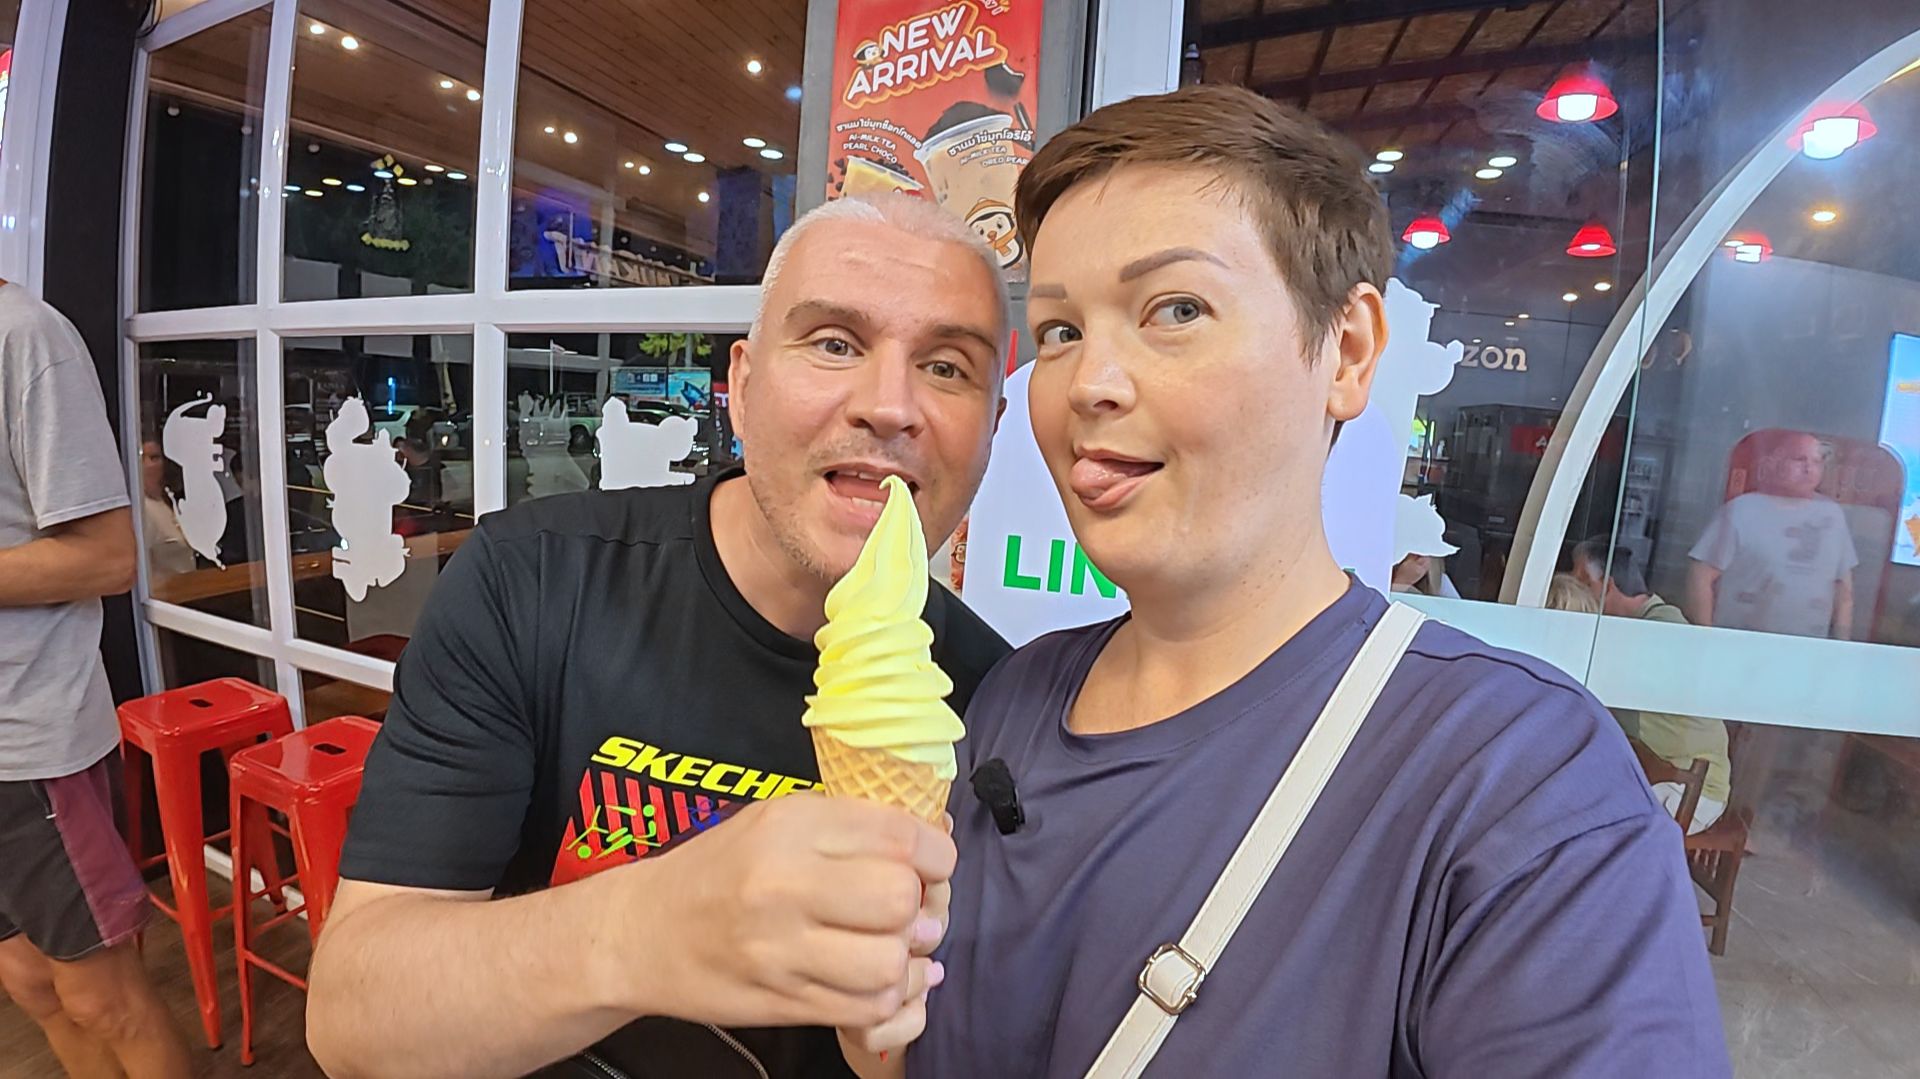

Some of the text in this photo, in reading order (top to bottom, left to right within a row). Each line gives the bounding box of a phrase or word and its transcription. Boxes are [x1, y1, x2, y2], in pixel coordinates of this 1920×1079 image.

[882, 5, 966, 57] NEW
[847, 30, 996, 100] ARRIVAL
[843, 142, 898, 164] PEARL CHOCO
[881, 138, 897, 151] TEA
[991, 146, 1007, 154] TEA
[1003, 534, 1129, 600] LIN
[591, 736, 826, 800] SKECHE
